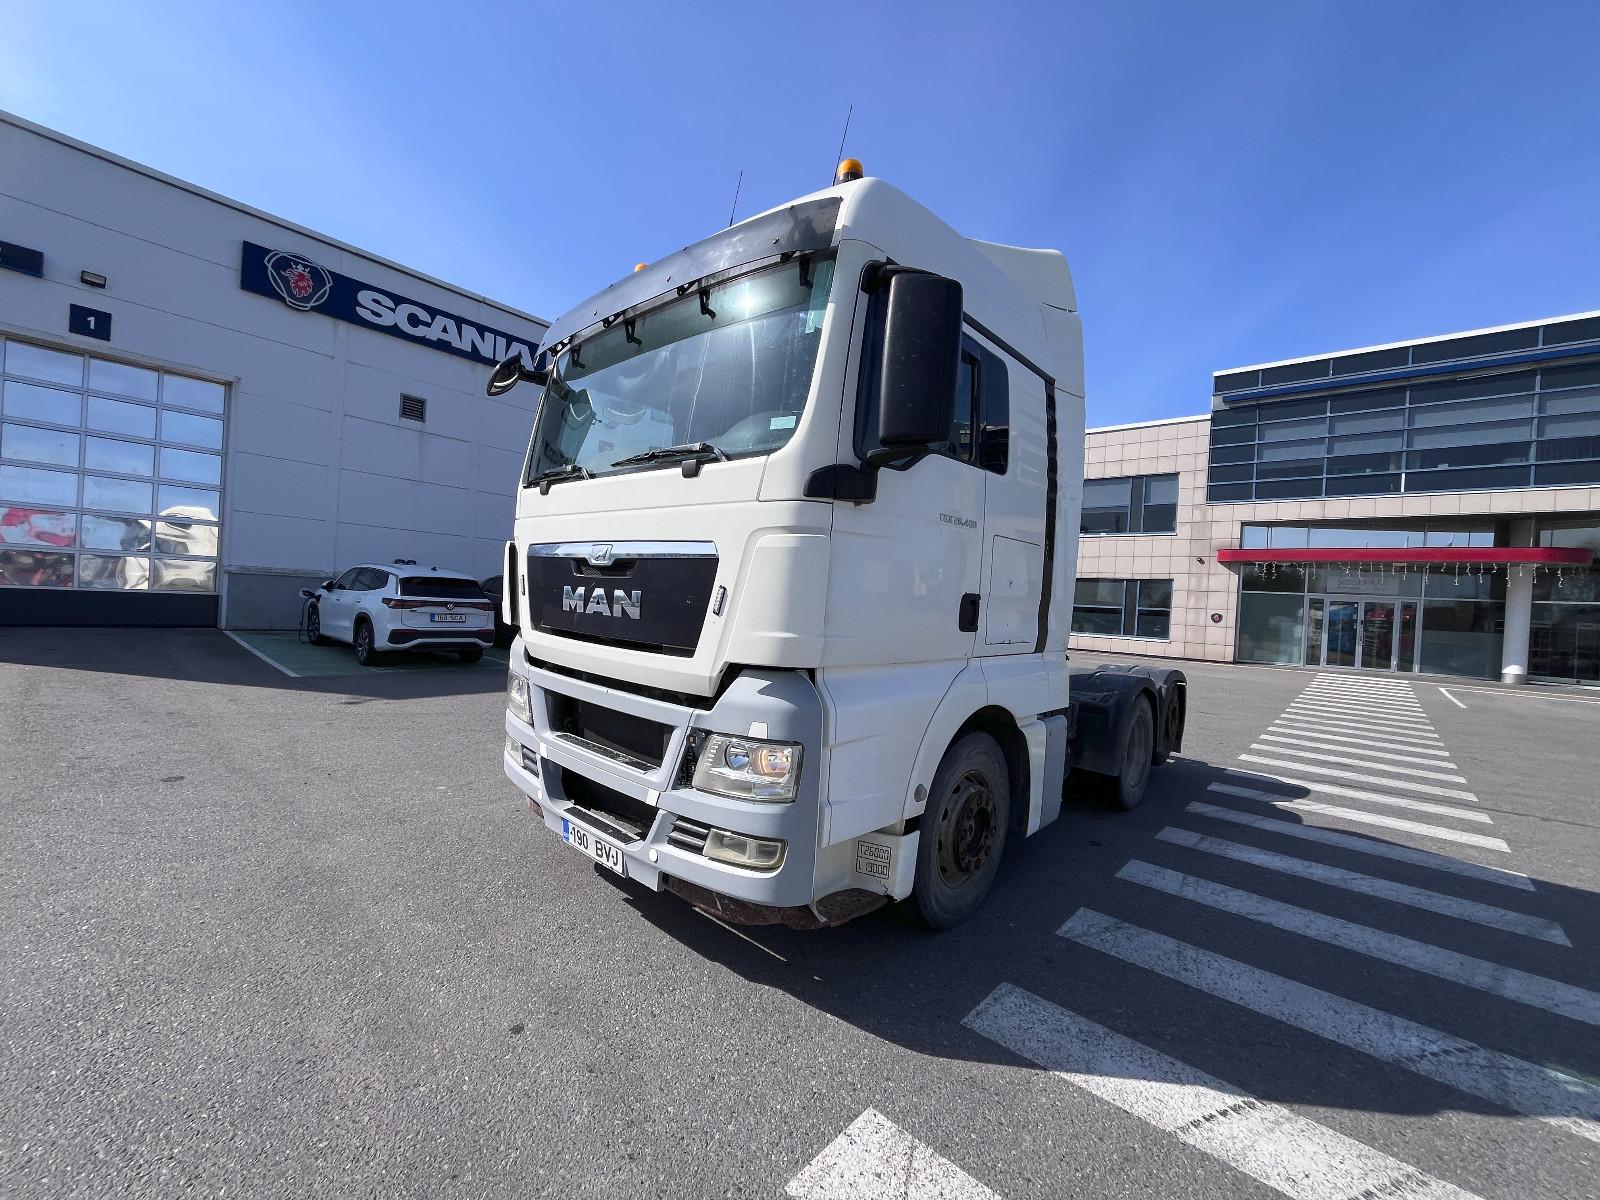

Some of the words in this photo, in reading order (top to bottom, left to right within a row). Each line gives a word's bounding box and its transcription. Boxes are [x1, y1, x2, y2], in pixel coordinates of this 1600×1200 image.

[87, 316, 95, 330] 1
[355, 290, 535, 371] SCANIA
[562, 585, 642, 619] MAN
[570, 826, 588, 850] 190
[595, 839, 619, 867] BVJ
